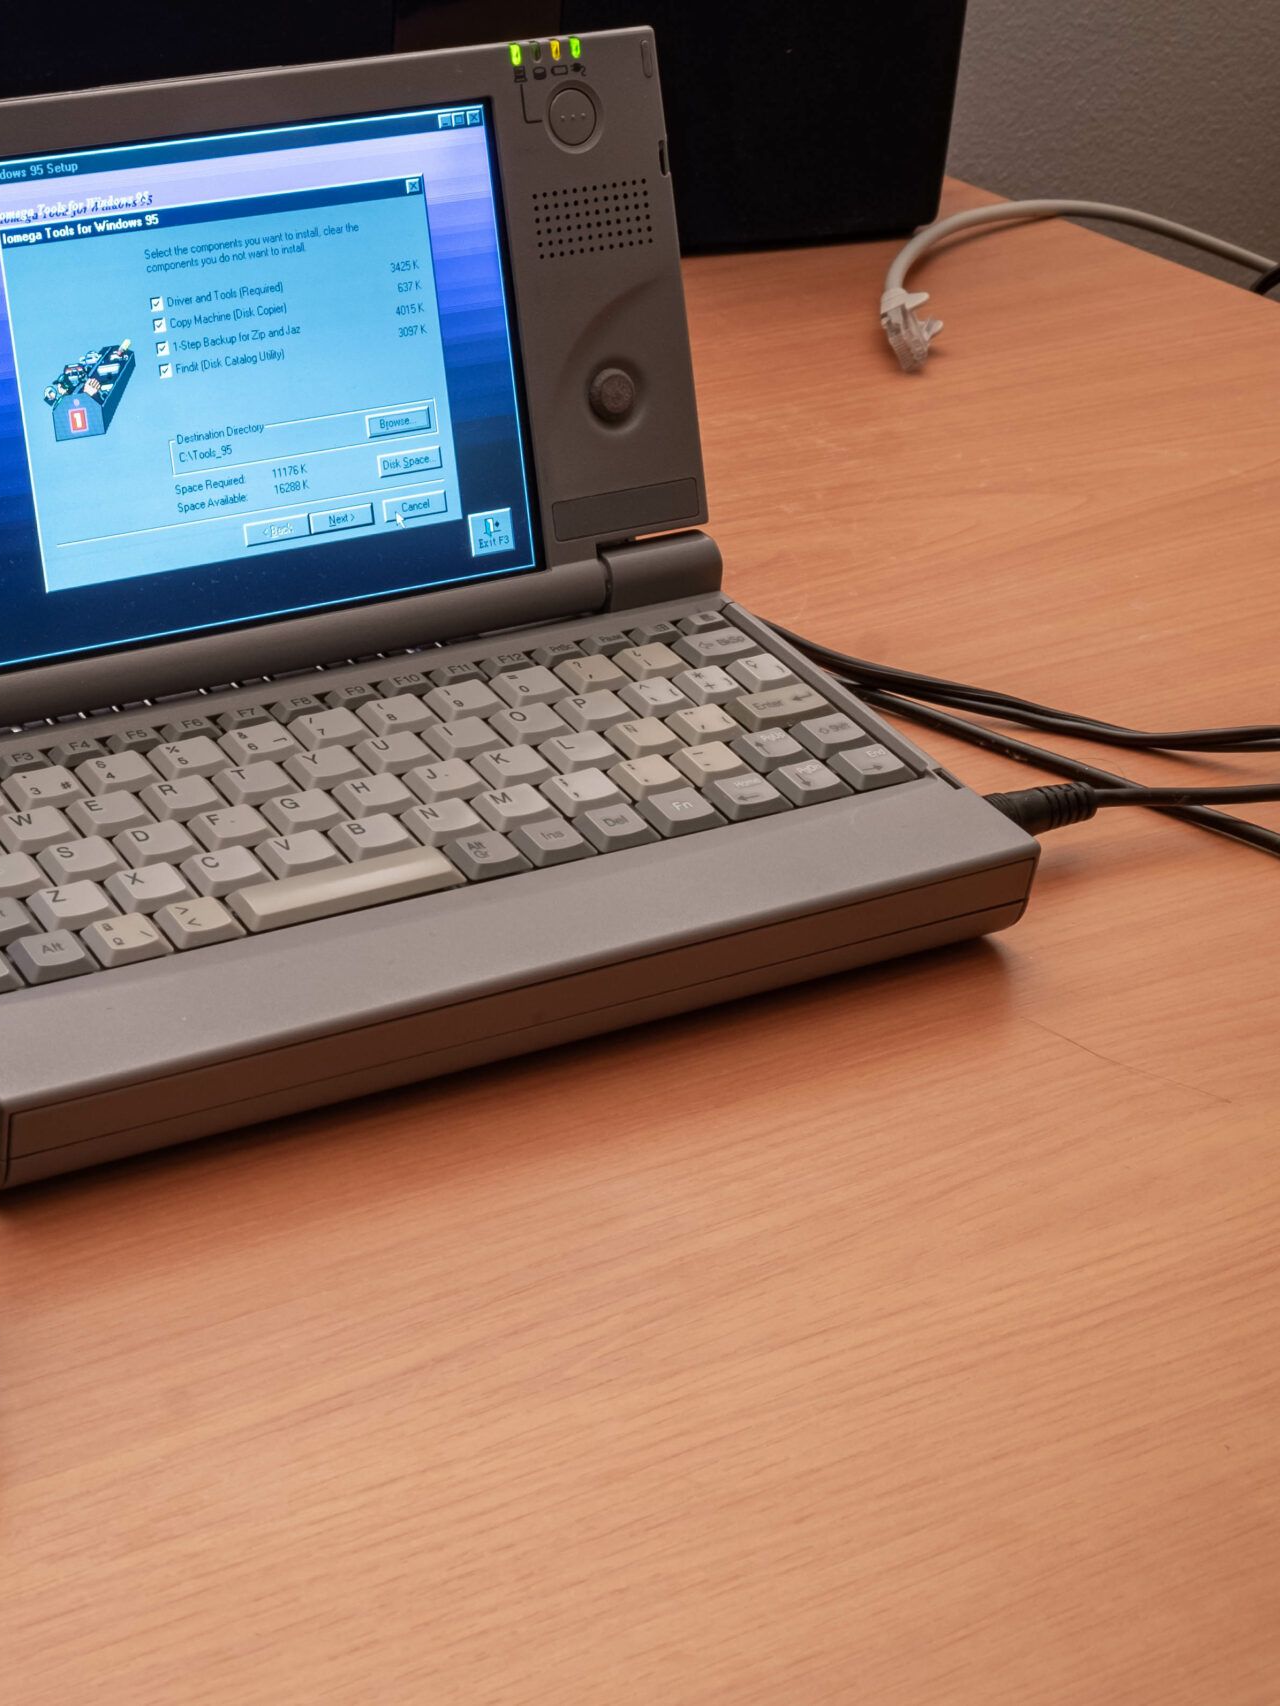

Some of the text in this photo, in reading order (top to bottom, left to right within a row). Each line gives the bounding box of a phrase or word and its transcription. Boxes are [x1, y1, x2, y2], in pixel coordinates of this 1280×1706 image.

[30, 165, 43, 176] 95
[47, 162, 78, 174] Setup
[2, 213, 159, 245] Iomega Tools for Windows 95
[144, 247, 171, 260] Select
[174, 244, 188, 257] the
[190, 239, 243, 254] components
[245, 237, 260, 250] you
[263, 233, 283, 245] want
[285, 231, 293, 241] to
[323, 225, 343, 236] clear
[345, 223, 359, 233] the
[146, 258, 198, 273] components
[201, 257, 217, 269] you
[219, 253, 230, 264] do
[232, 250, 246, 262] not
[248, 248, 269, 260] want
[271, 246, 280, 256] to
[391, 259, 420, 273] 3425 K
[398, 280, 422, 293] 637 K
[167, 296, 193, 308] Driver
[195, 292, 212, 303] and
[214, 289, 237, 300] Tools
[396, 303, 425, 316] 4015 K
[170, 316, 192, 329] Copy
[194, 310, 231, 324] Machine
[398, 324, 428, 338] 3097 K
[173, 325, 301, 352] 1-Step Backup for Zip and Jaz
[225, 353, 257, 367] Catalog
[176, 423, 264, 445] Destination Directory
[383, 458, 401, 470] Disk
[272, 464, 308, 479] 11176 K
[175, 481, 203, 495] Space
[274, 480, 309, 494] 16288 K
[177, 499, 206, 513] Space
[402, 499, 430, 512] Cancel
[328, 513, 348, 527] Next
[270, 523, 294, 538] Back
[478, 535, 509, 549] Exit F3
[497, 653, 522, 664] F12
[447, 663, 471, 675] F11
[393, 674, 420, 687] F10
[344, 685, 366, 697] F9
[290, 696, 312, 708] F8
[752, 699, 786, 712] Enter
[237, 708, 256, 719] F7
[181, 718, 204, 730] F6
[125, 729, 147, 740] F5
[70, 740, 91, 751] F4
[12, 752, 34, 763] F3
[867, 746, 887, 759] End
[489, 753, 511, 766] K
[157, 784, 179, 796] R
[351, 781, 371, 794] H
[279, 798, 300, 810] G
[489, 792, 513, 805] M
[83, 800, 104, 812] E
[672, 800, 694, 812] Fn
[419, 807, 440, 819] N
[9, 814, 33, 828] W
[603, 815, 629, 828] Del
[346, 823, 366, 836] B
[541, 829, 565, 841] Ins
[131, 830, 150, 843] D
[274, 839, 292, 851] V
[467, 840, 485, 852] Alt
[56, 847, 75, 859] S
[201, 856, 220, 869] C
[124, 872, 145, 885] X
[41, 941, 65, 955] Alt
